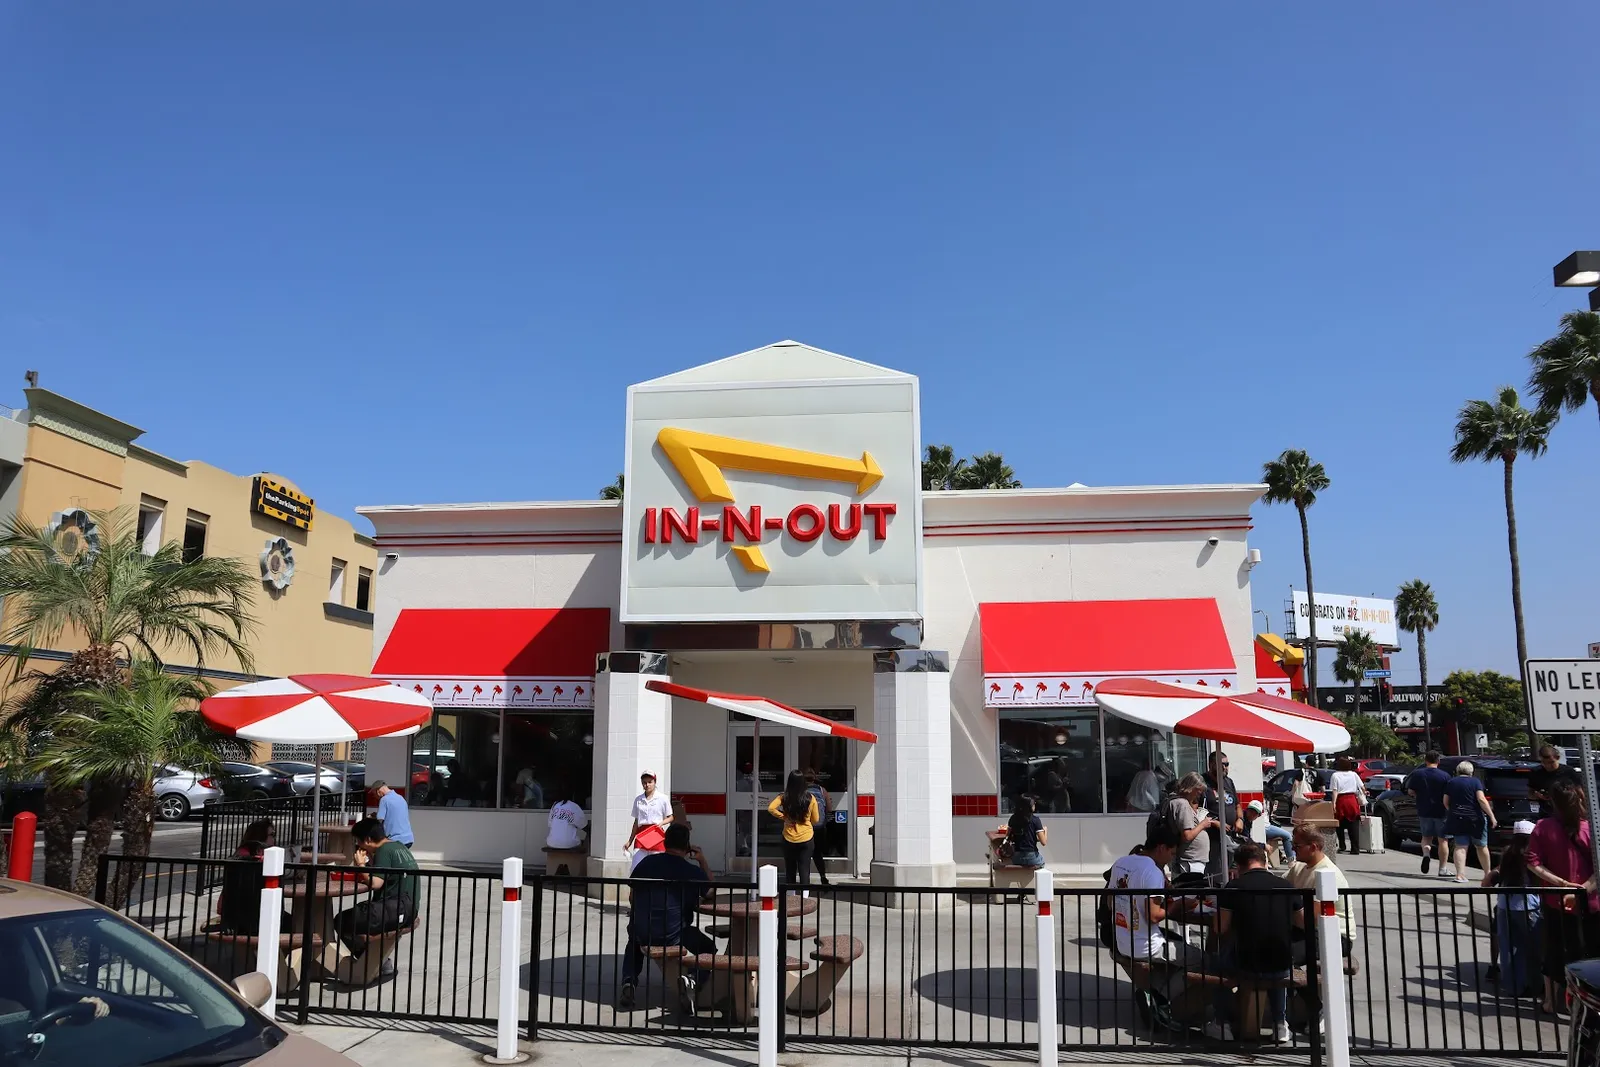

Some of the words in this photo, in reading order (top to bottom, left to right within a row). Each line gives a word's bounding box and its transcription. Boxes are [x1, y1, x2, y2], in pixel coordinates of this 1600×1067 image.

[644, 503, 897, 544] IN-N-OUT
[1300, 603, 1334, 620] COGRATS
[1335, 606, 1345, 620] ON
[1535, 670, 1559, 692] NO
[1567, 672, 1600, 690] LE
[1389, 692, 1429, 703] OLLYWOO
[1551, 701, 1600, 719] TUR
